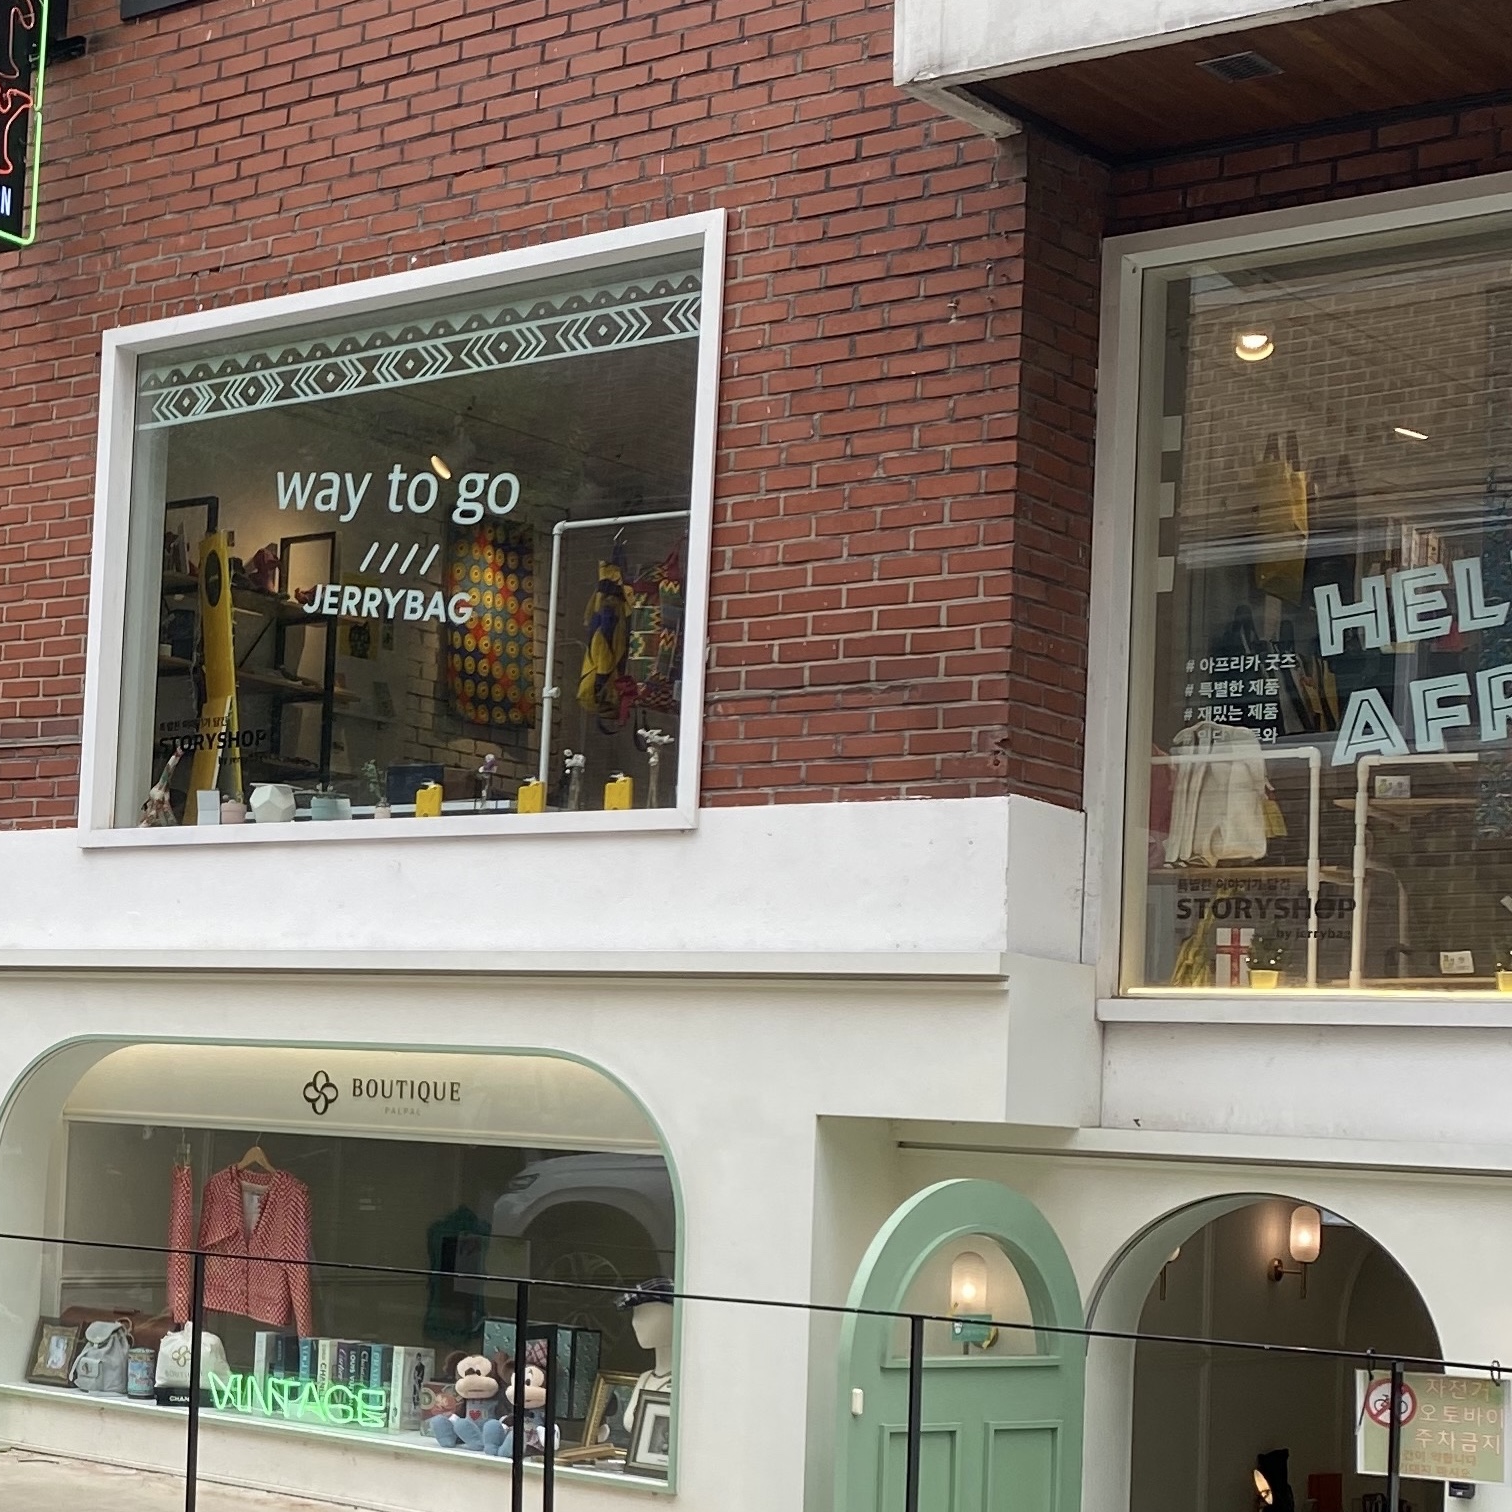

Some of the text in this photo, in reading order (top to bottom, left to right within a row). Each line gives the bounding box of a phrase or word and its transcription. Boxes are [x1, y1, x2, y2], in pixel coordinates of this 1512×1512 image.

[276, 463, 521, 525] way to go
[302, 583, 474, 626] JERRYBAG
[1199, 654, 1261, 674] 아프리카
[1265, 653, 1296, 671] 굿즈
[1198, 679, 1245, 699] 특별한
[1248, 678, 1280, 696] 제품
[1197, 705, 1243, 722] 재밌는
[1247, 703, 1279, 720] 제품
[159, 730, 266, 751] STORYSHOP
[1176, 897, 1356, 920] STORYSHOP
[352, 1078, 461, 1103] BOUTIQUE
[207, 1371, 386, 1428] VINTAGE
[1420, 1404, 1504, 1429] 오토바이
[1415, 1428, 1500, 1455] 주차금지
